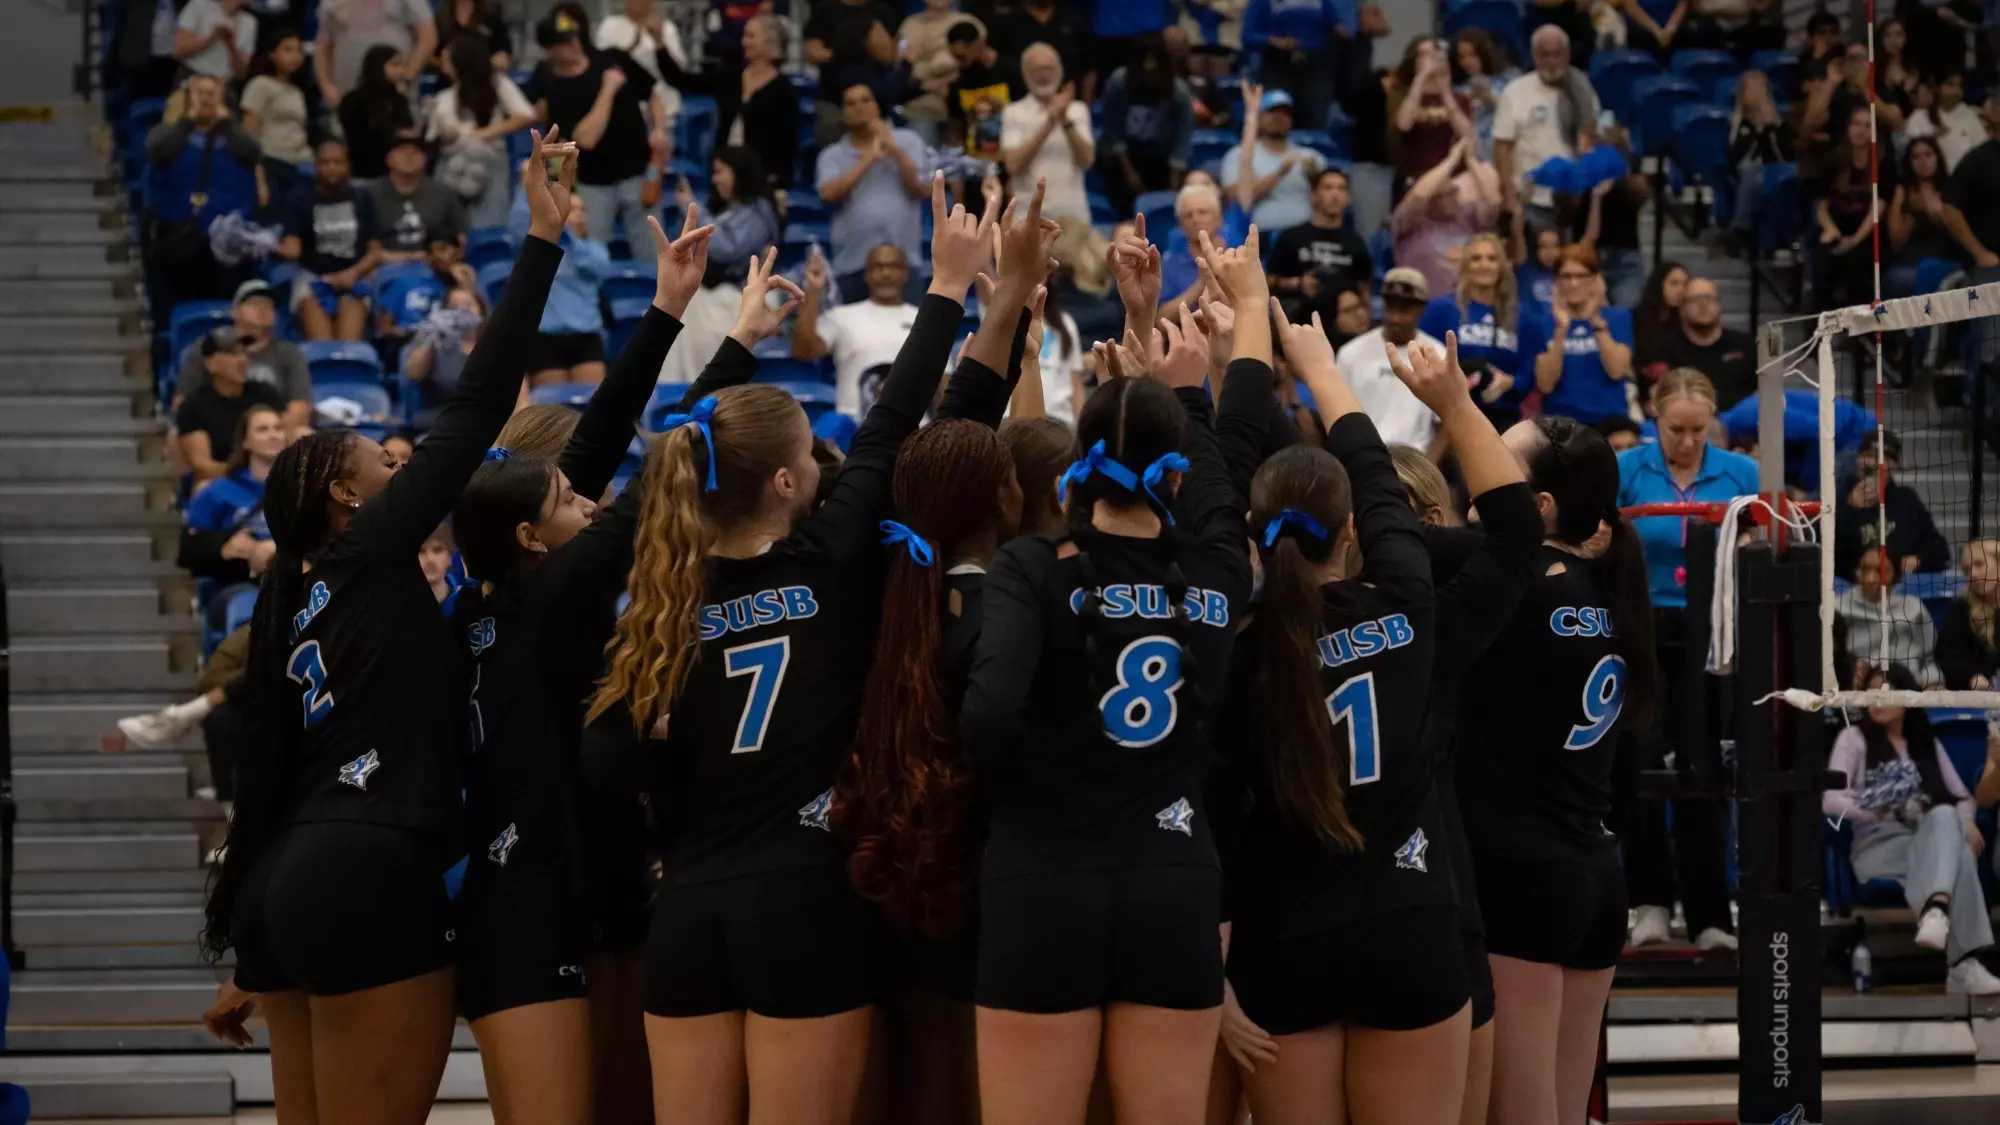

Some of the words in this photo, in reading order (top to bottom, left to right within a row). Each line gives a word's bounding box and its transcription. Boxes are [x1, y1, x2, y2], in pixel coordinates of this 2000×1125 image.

[286, 639, 335, 731] 2
[1316, 613, 1414, 669] USB
[724, 635, 790, 754] 7
[1098, 635, 1186, 748] 8
[1324, 671, 1381, 786] 1
[1563, 653, 1627, 751] 9
[1769, 931, 1791, 1000] sports
[1769, 1004, 1791, 1088] imports
